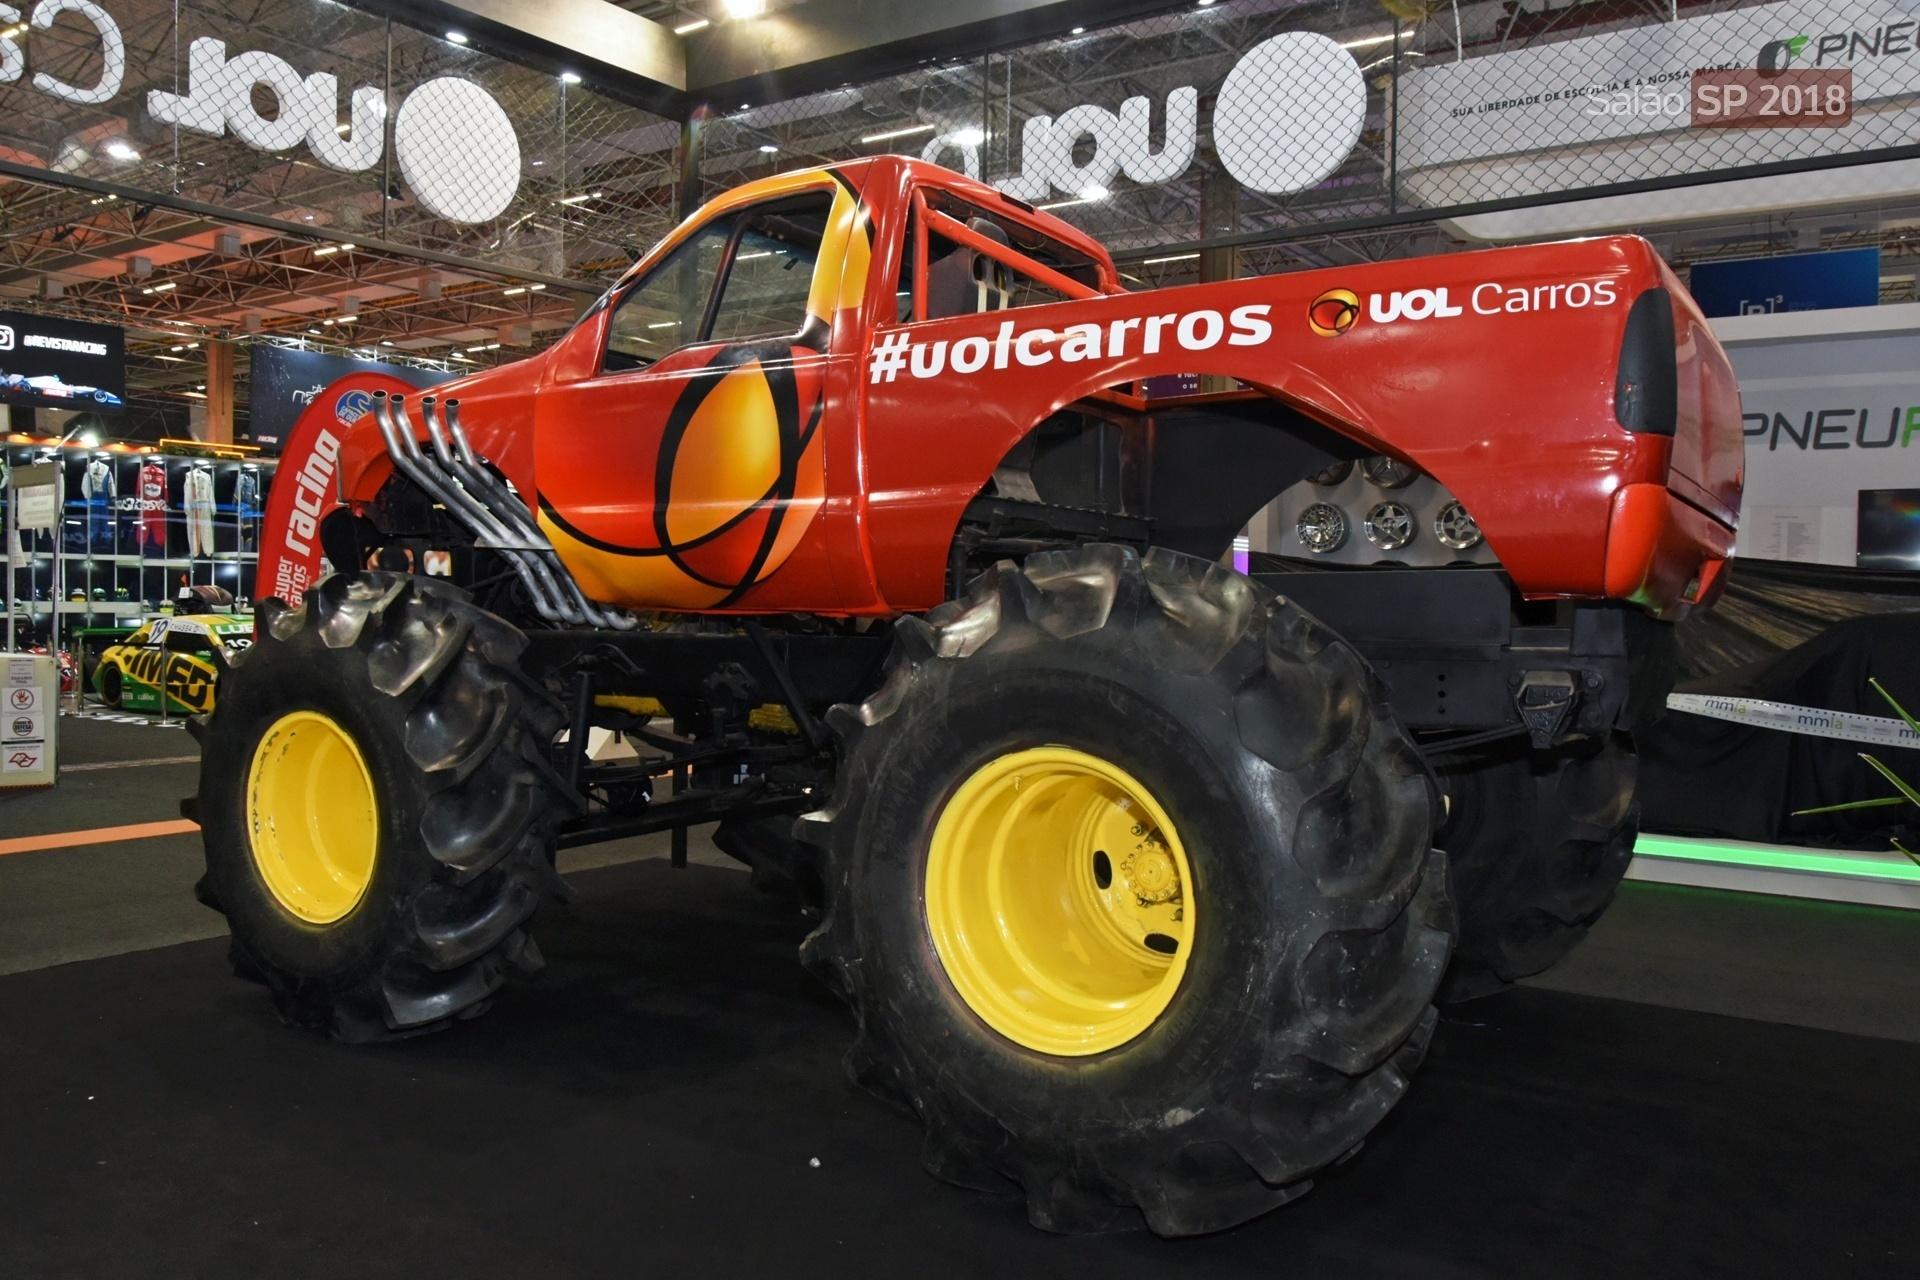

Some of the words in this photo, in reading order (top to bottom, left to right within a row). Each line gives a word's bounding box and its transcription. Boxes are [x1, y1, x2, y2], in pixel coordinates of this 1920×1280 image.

[1816, 21, 1920, 66] PNE
[1452, 106, 1474, 118] SUA
[1478, 95, 1541, 114] LIBERDADE
[1544, 91, 1561, 102] DE
[1636, 78, 1644, 87] A
[1648, 70, 1691, 86] NOSSA
[1369, 287, 1463, 323] UOL
[1472, 279, 1617, 315] Carros
[870, 304, 1273, 385] #uolcarros
[274, 555, 295, 601] super
